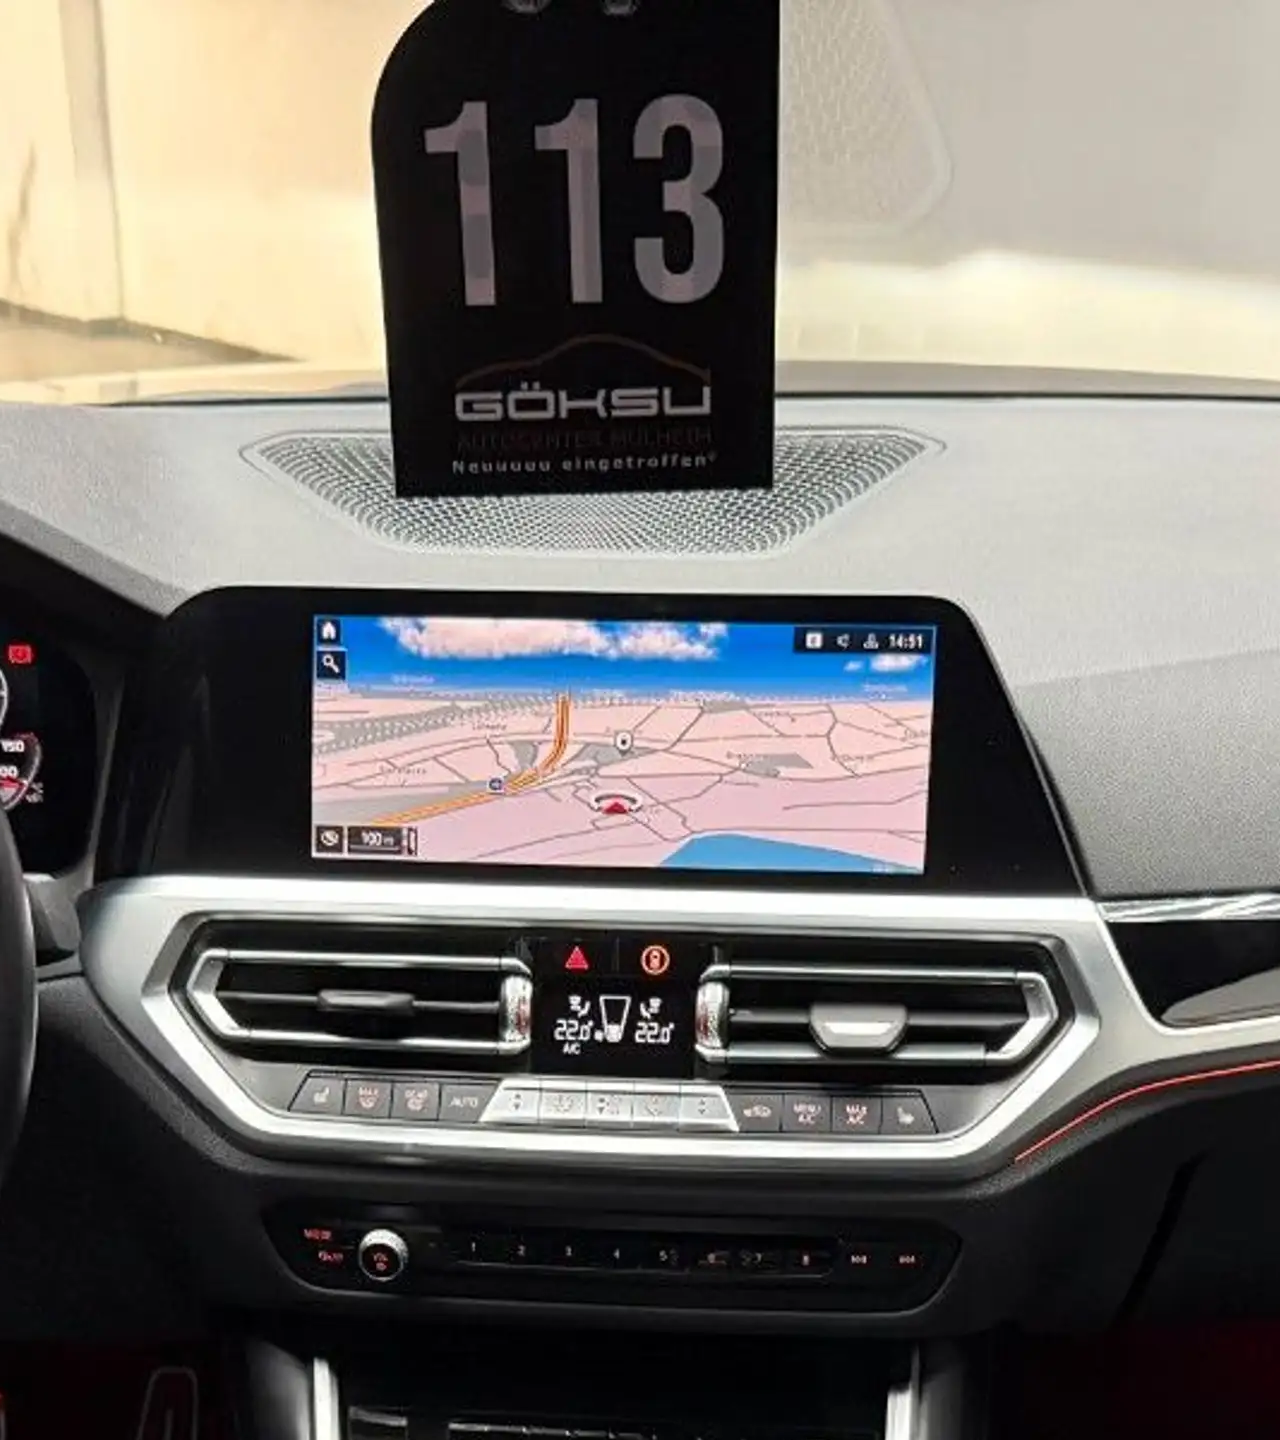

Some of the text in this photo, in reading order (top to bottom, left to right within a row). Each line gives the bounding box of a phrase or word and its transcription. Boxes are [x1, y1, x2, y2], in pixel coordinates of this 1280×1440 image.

[425, 94, 724, 306] 113
[455, 382, 711, 421] GÖKSU
[0, 739, 25, 753] 150
